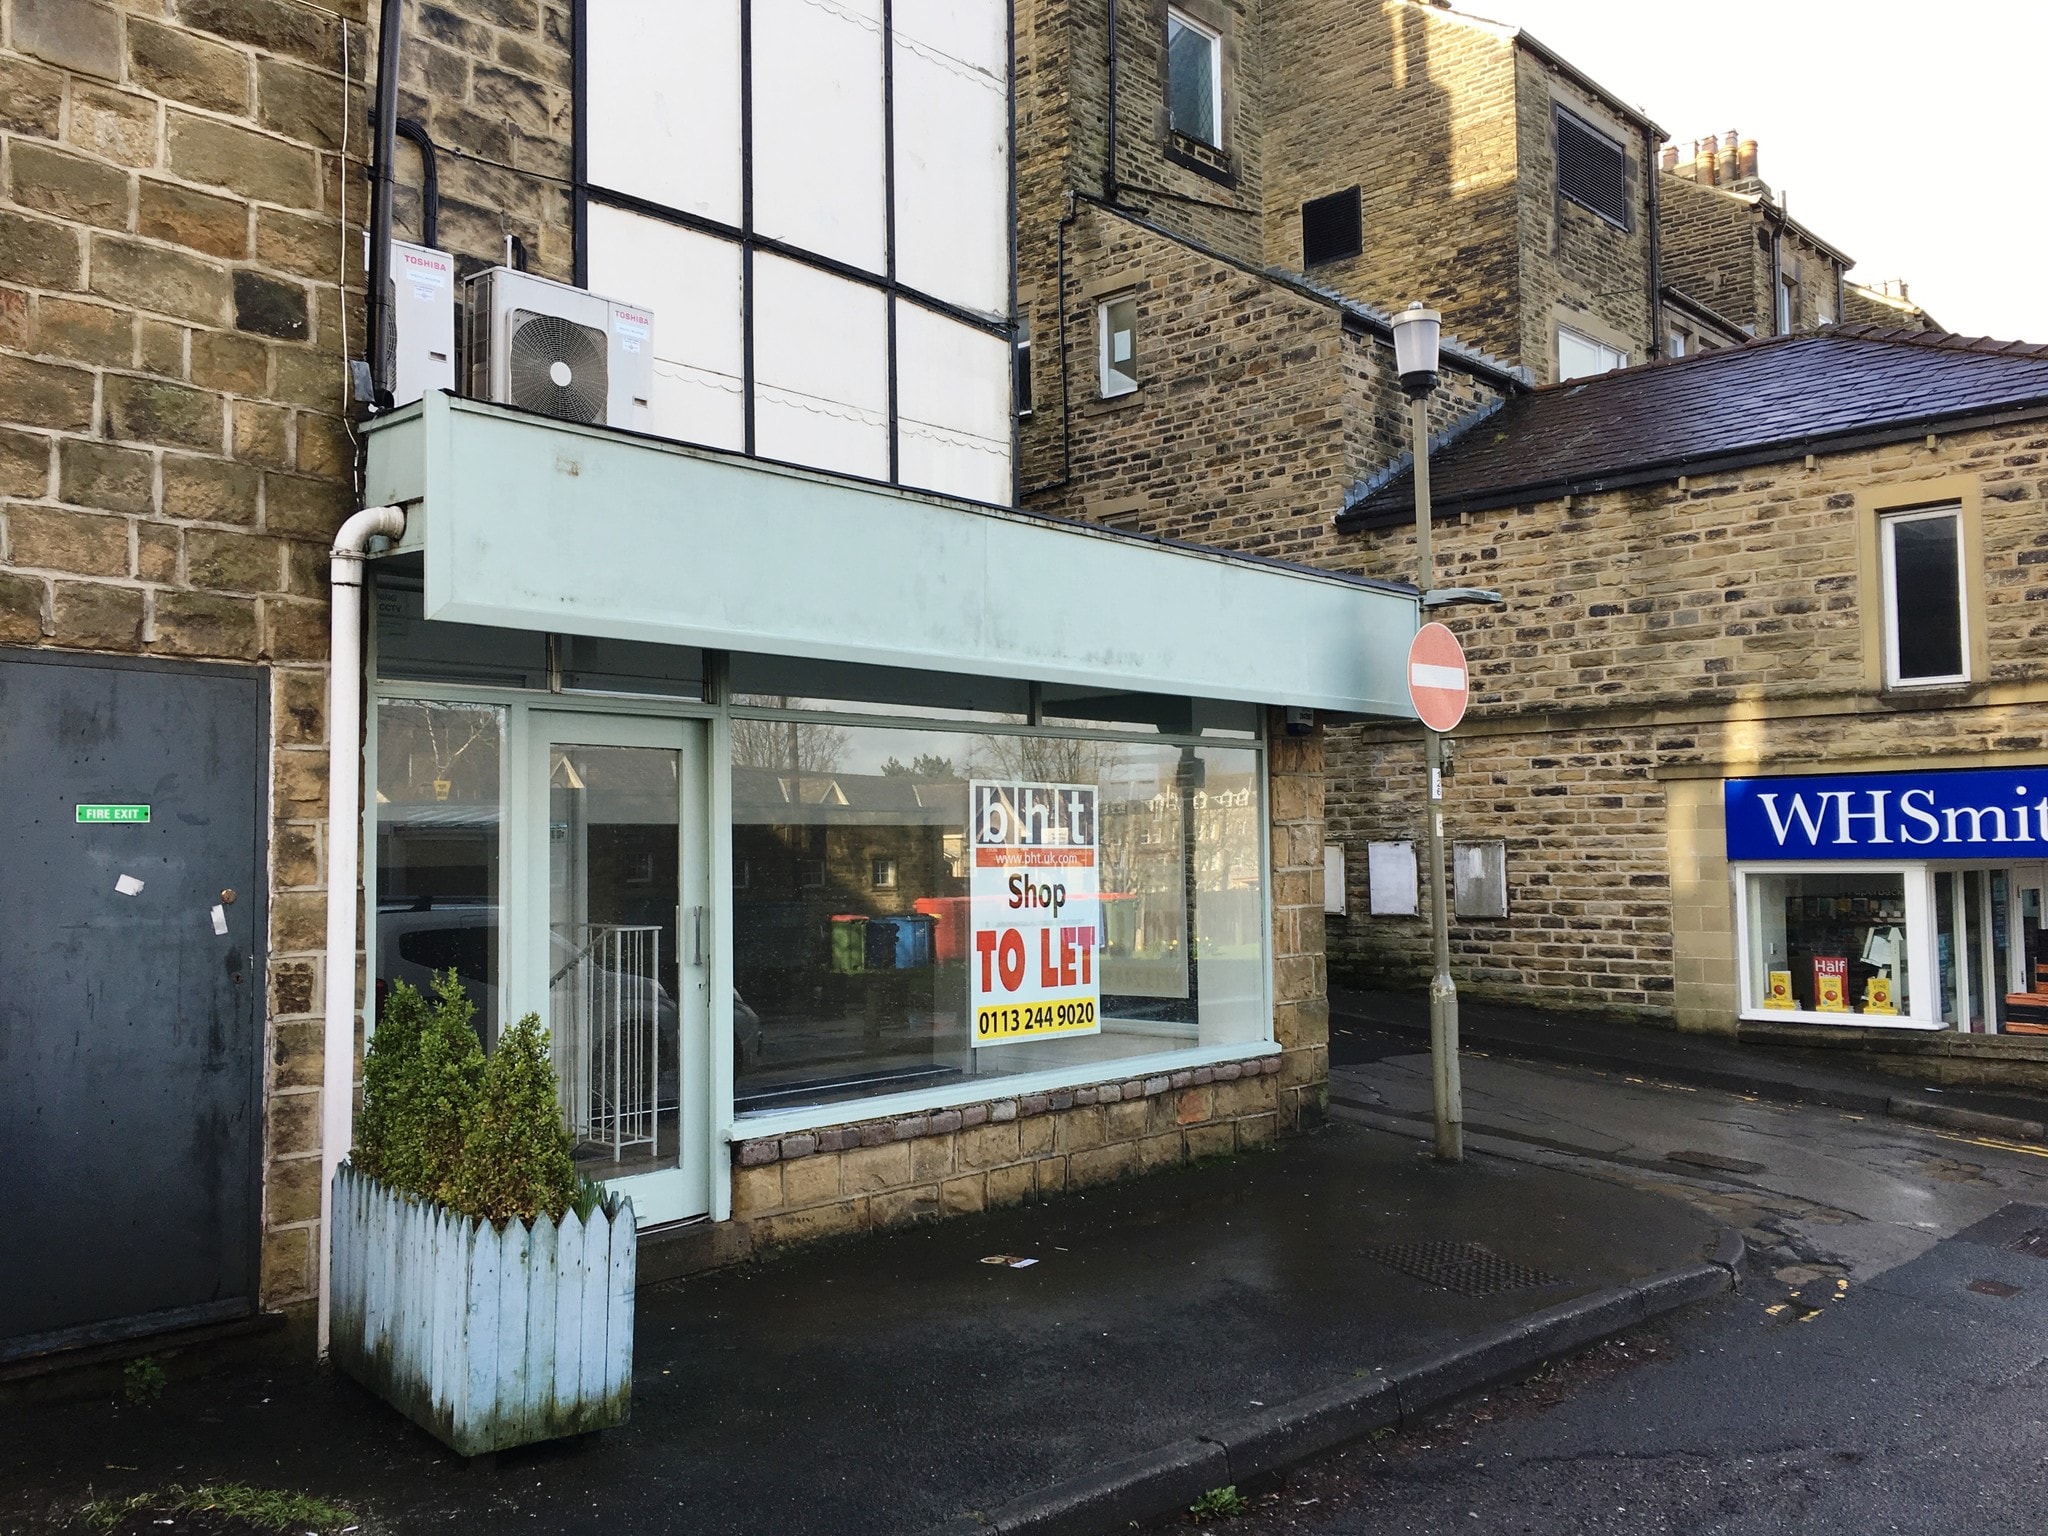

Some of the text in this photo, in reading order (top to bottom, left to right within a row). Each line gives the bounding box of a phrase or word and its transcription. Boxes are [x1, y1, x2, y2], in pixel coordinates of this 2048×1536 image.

[404, 254, 447, 272] TOSHIBA
[615, 310, 649, 326] TOSHIBA
[379, 603, 402, 613] CCTV
[86, 809, 139, 819] FIRE EXIT
[982, 787, 1085, 844] bht
[995, 851, 1078, 865] www.bht.uk.com
[1008, 873, 1066, 918] Shop
[1848, 887, 1904, 897] aperback
[976, 926, 1096, 992] TO LET
[1814, 960, 1846, 973] Half
[979, 1001, 1094, 1035] 0113 244 9020
